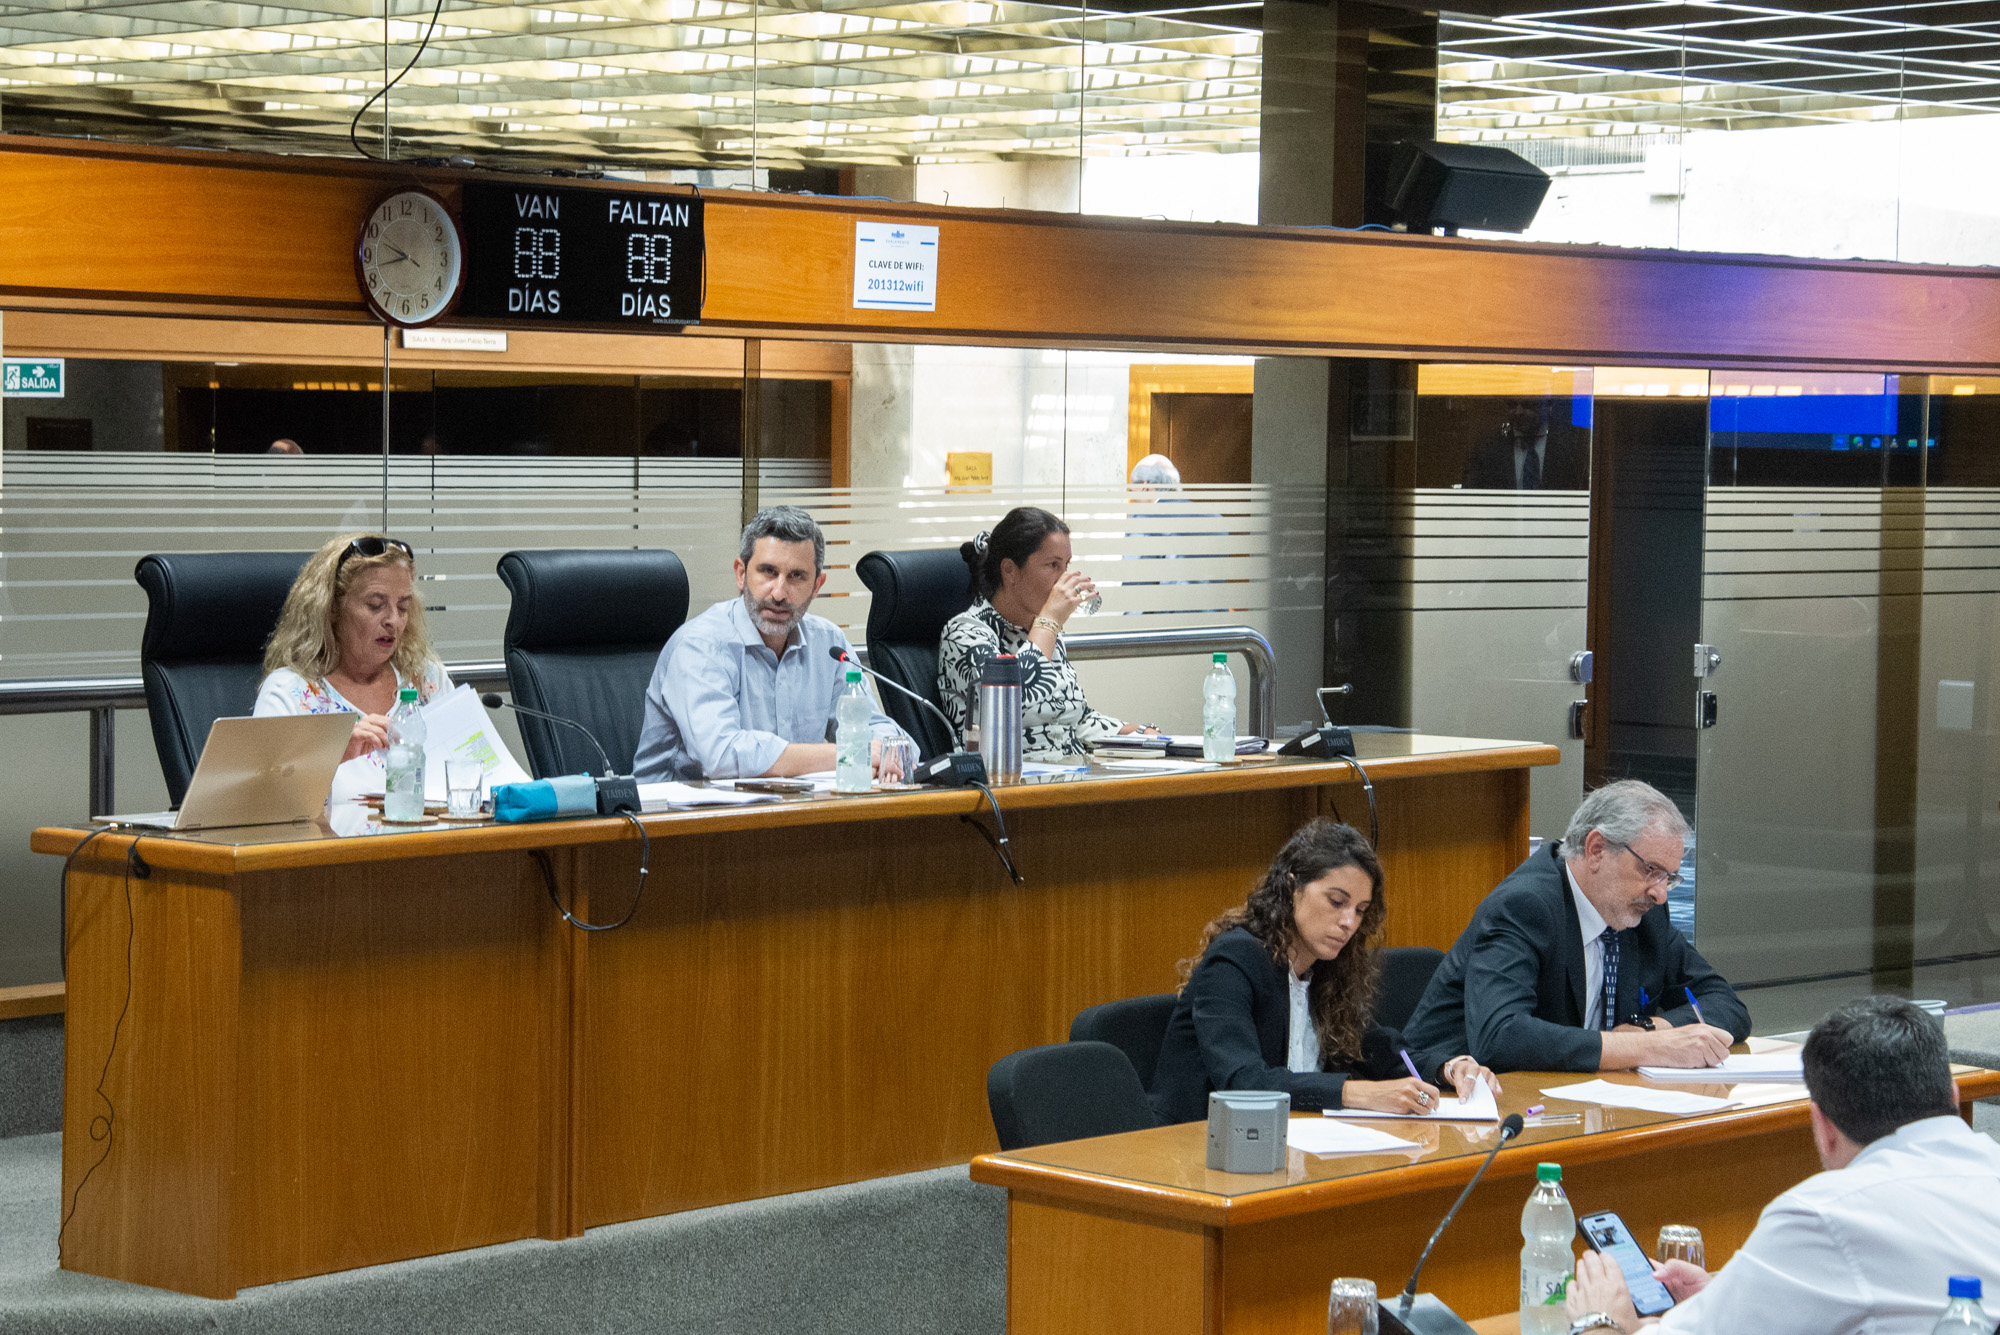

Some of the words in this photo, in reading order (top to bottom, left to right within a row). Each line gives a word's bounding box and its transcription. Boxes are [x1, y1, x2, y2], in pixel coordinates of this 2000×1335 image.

[382, 205, 392, 221] 11
[400, 200, 412, 216] 12
[515, 193, 560, 220] VAN
[608, 199, 690, 228] FALTAN
[366, 222, 379, 239] 10
[435, 226, 443, 242] 2
[363, 247, 372, 264] 9
[440, 251, 448, 267] 3
[868, 259, 893, 270] CLAVE
[893, 261, 904, 270] DE
[905, 262, 925, 271] WIFI:
[368, 272, 377, 289] 8
[434, 276, 442, 291] 4
[867, 278, 924, 292] 201312wifi
[383, 292, 391, 308] 7
[421, 293, 429, 309] 5
[508, 282, 561, 314] DÍAS
[621, 287, 671, 318] DÍAS
[401, 299, 410, 316] 6
[21, 377, 57, 389] SALIDA
